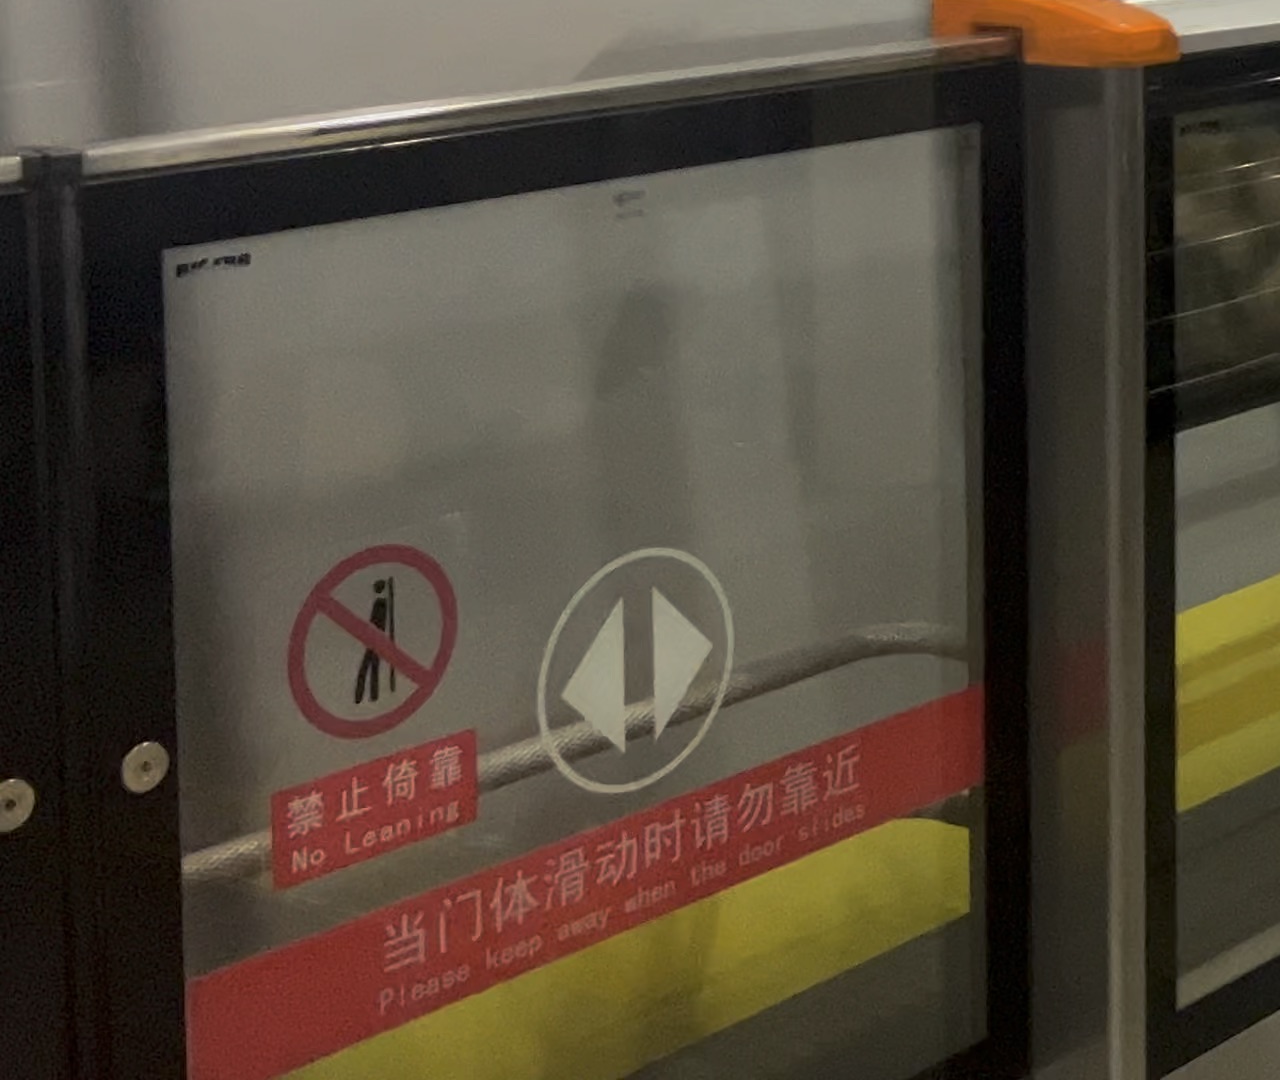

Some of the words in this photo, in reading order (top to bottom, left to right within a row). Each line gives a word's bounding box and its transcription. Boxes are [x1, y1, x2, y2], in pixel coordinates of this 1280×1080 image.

[287, 745, 463, 839] 禁止倚靠
[292, 846, 327, 874] No
[345, 800, 460, 855] Leaning
[383, 743, 861, 973] 当门体滑动时请勿靠近
[379, 964, 471, 1016] Please
[486, 934, 543, 970] keep
[557, 906, 612, 941] away
[624, 880, 678, 913] when
[690, 858, 728, 887] the
[738, 835, 784, 866] door
[798, 804, 866, 842] slides
